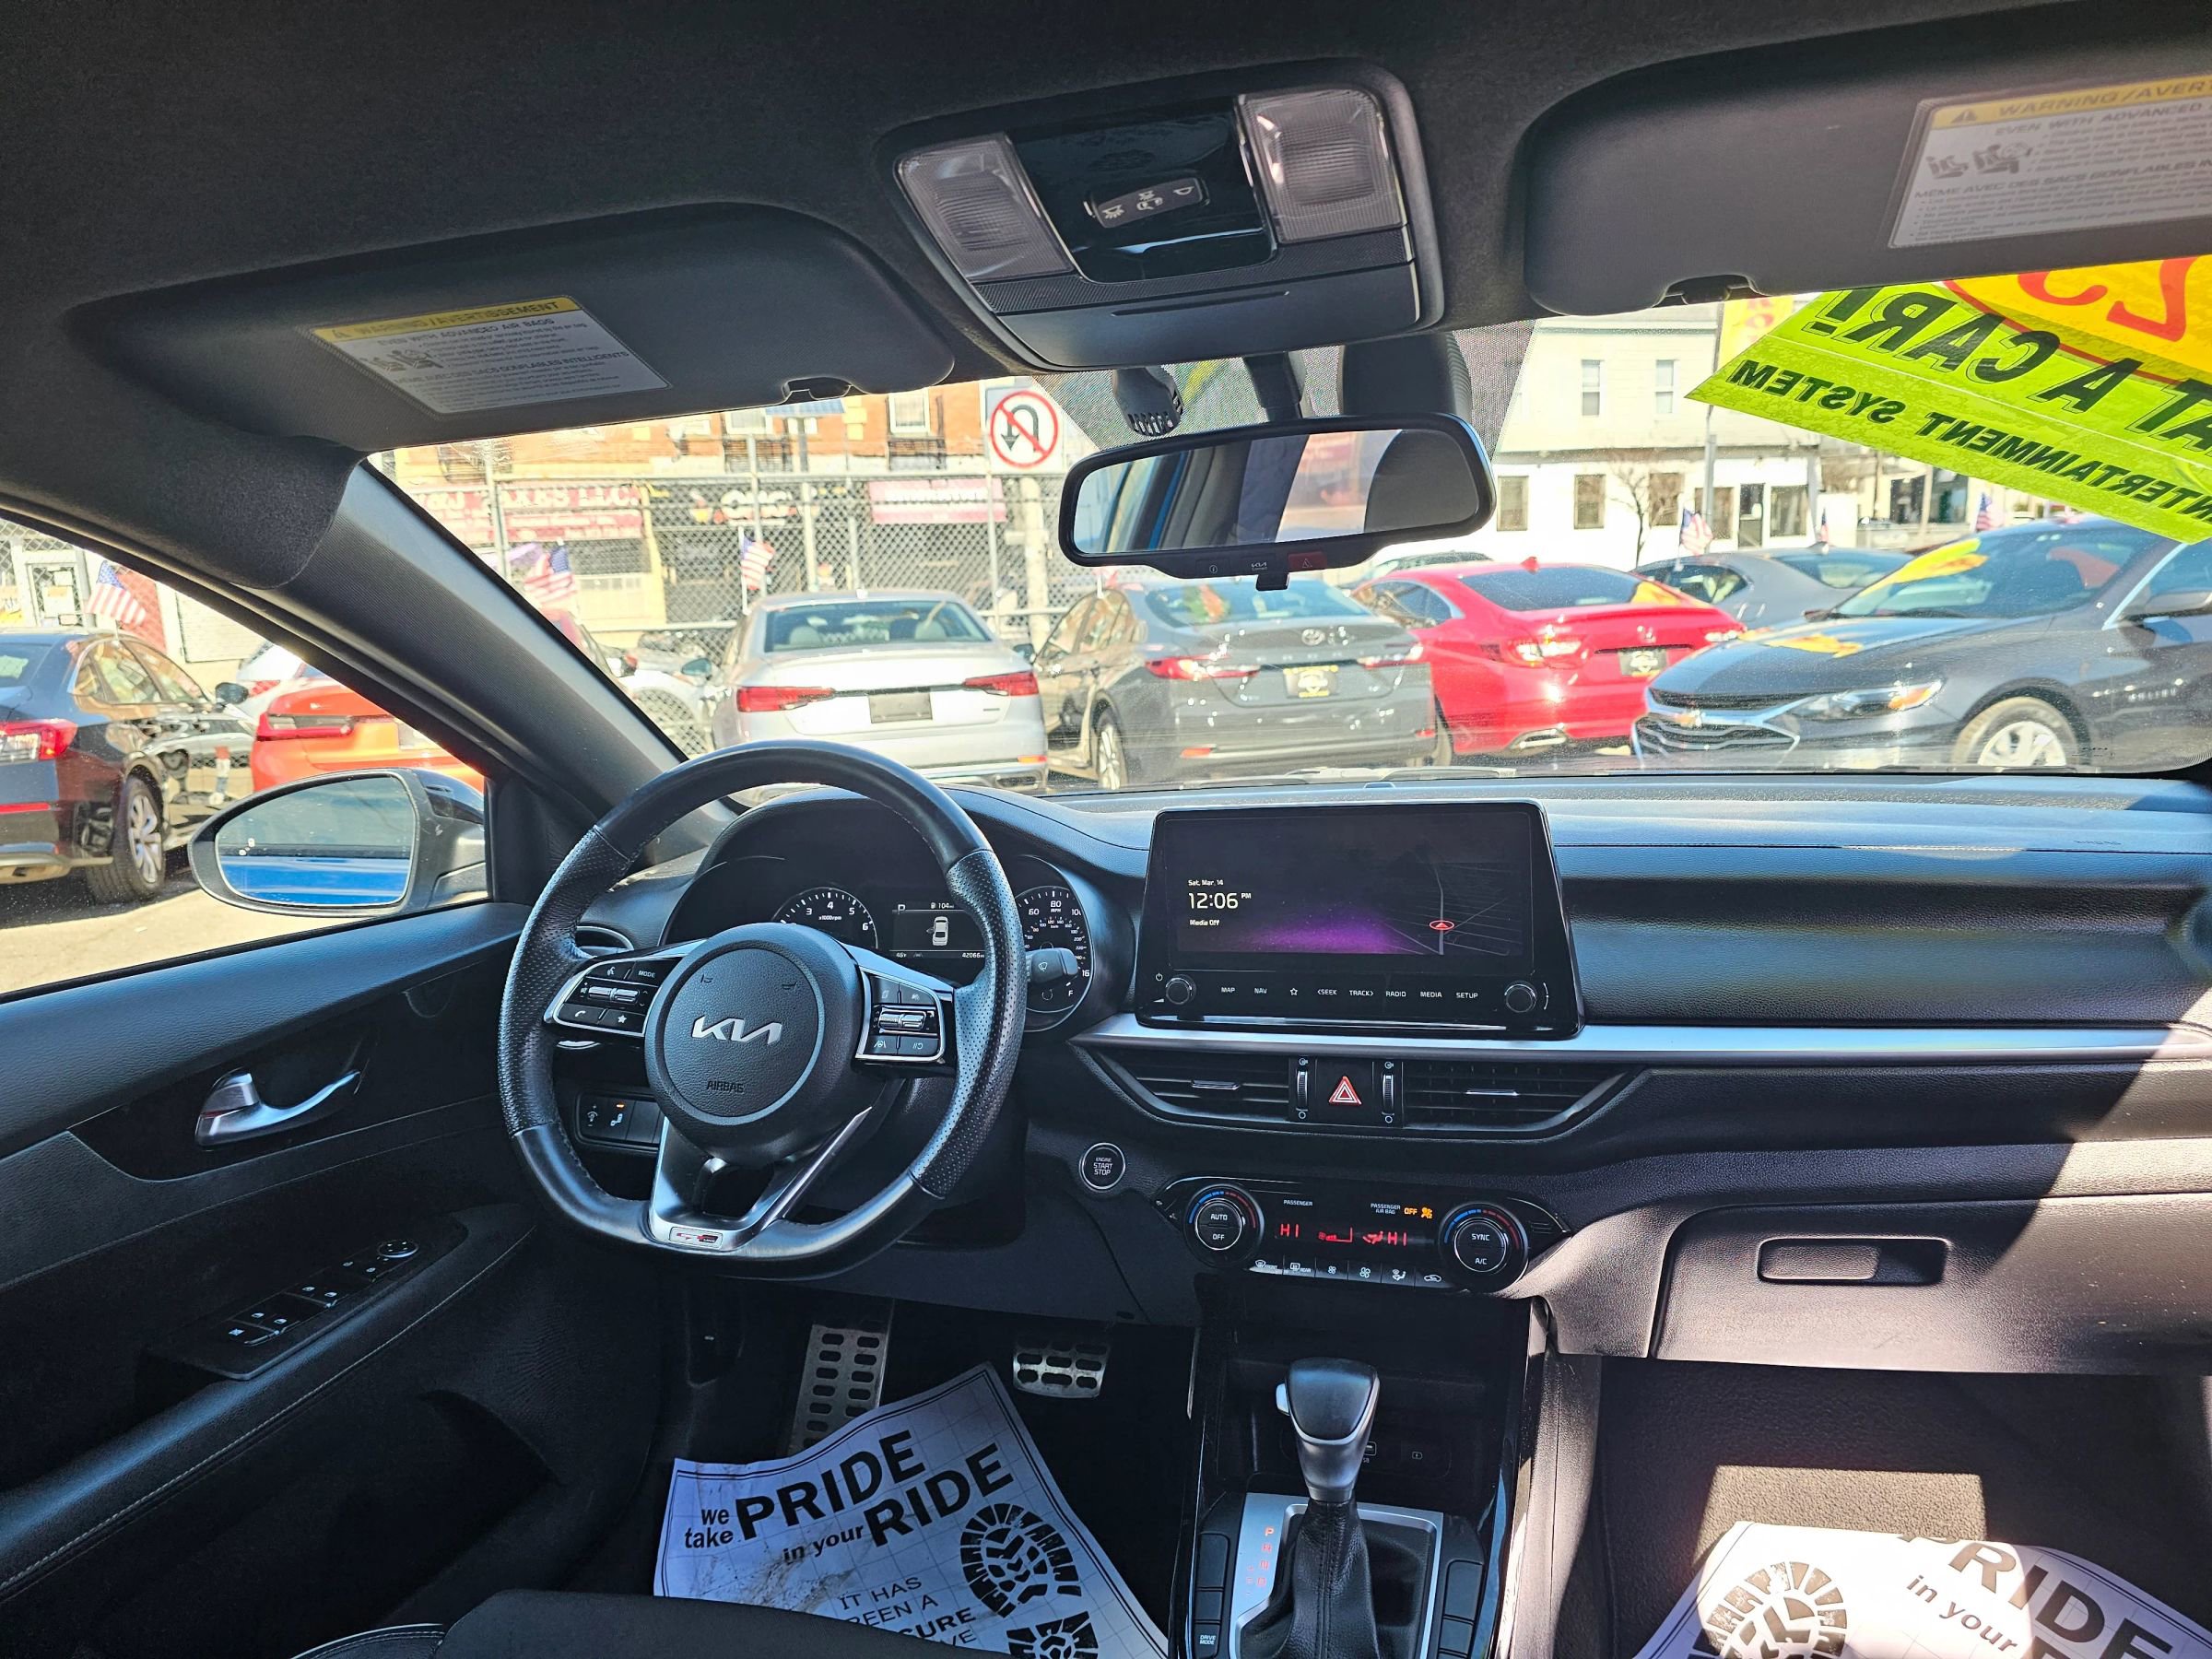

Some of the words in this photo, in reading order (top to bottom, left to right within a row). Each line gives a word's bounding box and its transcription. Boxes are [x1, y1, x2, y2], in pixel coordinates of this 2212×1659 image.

[2100, 102, 2203, 122] ADVANCED
[827, 900, 834, 909] 4
[1188, 892, 1239, 910] 12:06
[849, 907, 855, 915] 5
[898, 904, 906, 914] P
[862, 923, 869, 931] 6
[638, 970, 656, 978] MODE
[691, 1016, 783, 1045] KIA
[1370, 1202, 1401, 1210] PASSENGER
[1404, 1207, 1418, 1216] OFF
[1210, 1213, 1228, 1221] AUTO
[1212, 1233, 1225, 1241] OFF
[1471, 1233, 1490, 1241] SYNC
[1475, 1257, 1488, 1265] A/C
[684, 1526, 734, 1548] take
[735, 1430, 924, 1540] PRIDE
[783, 1546, 806, 1566] in
[812, 1524, 865, 1559] your
[864, 1443, 1015, 1547] RIDE
[701, 1507, 729, 1526] we
[1265, 1526, 1275, 1536] P
[840, 1593, 861, 1610] IT
[871, 1577, 922, 1602] HAS
[1897, 1535, 2173, 1659] RIDE
[922, 1594, 938, 1611] A
[1906, 1575, 1937, 1604] in
[1939, 1601, 2018, 1652] your
